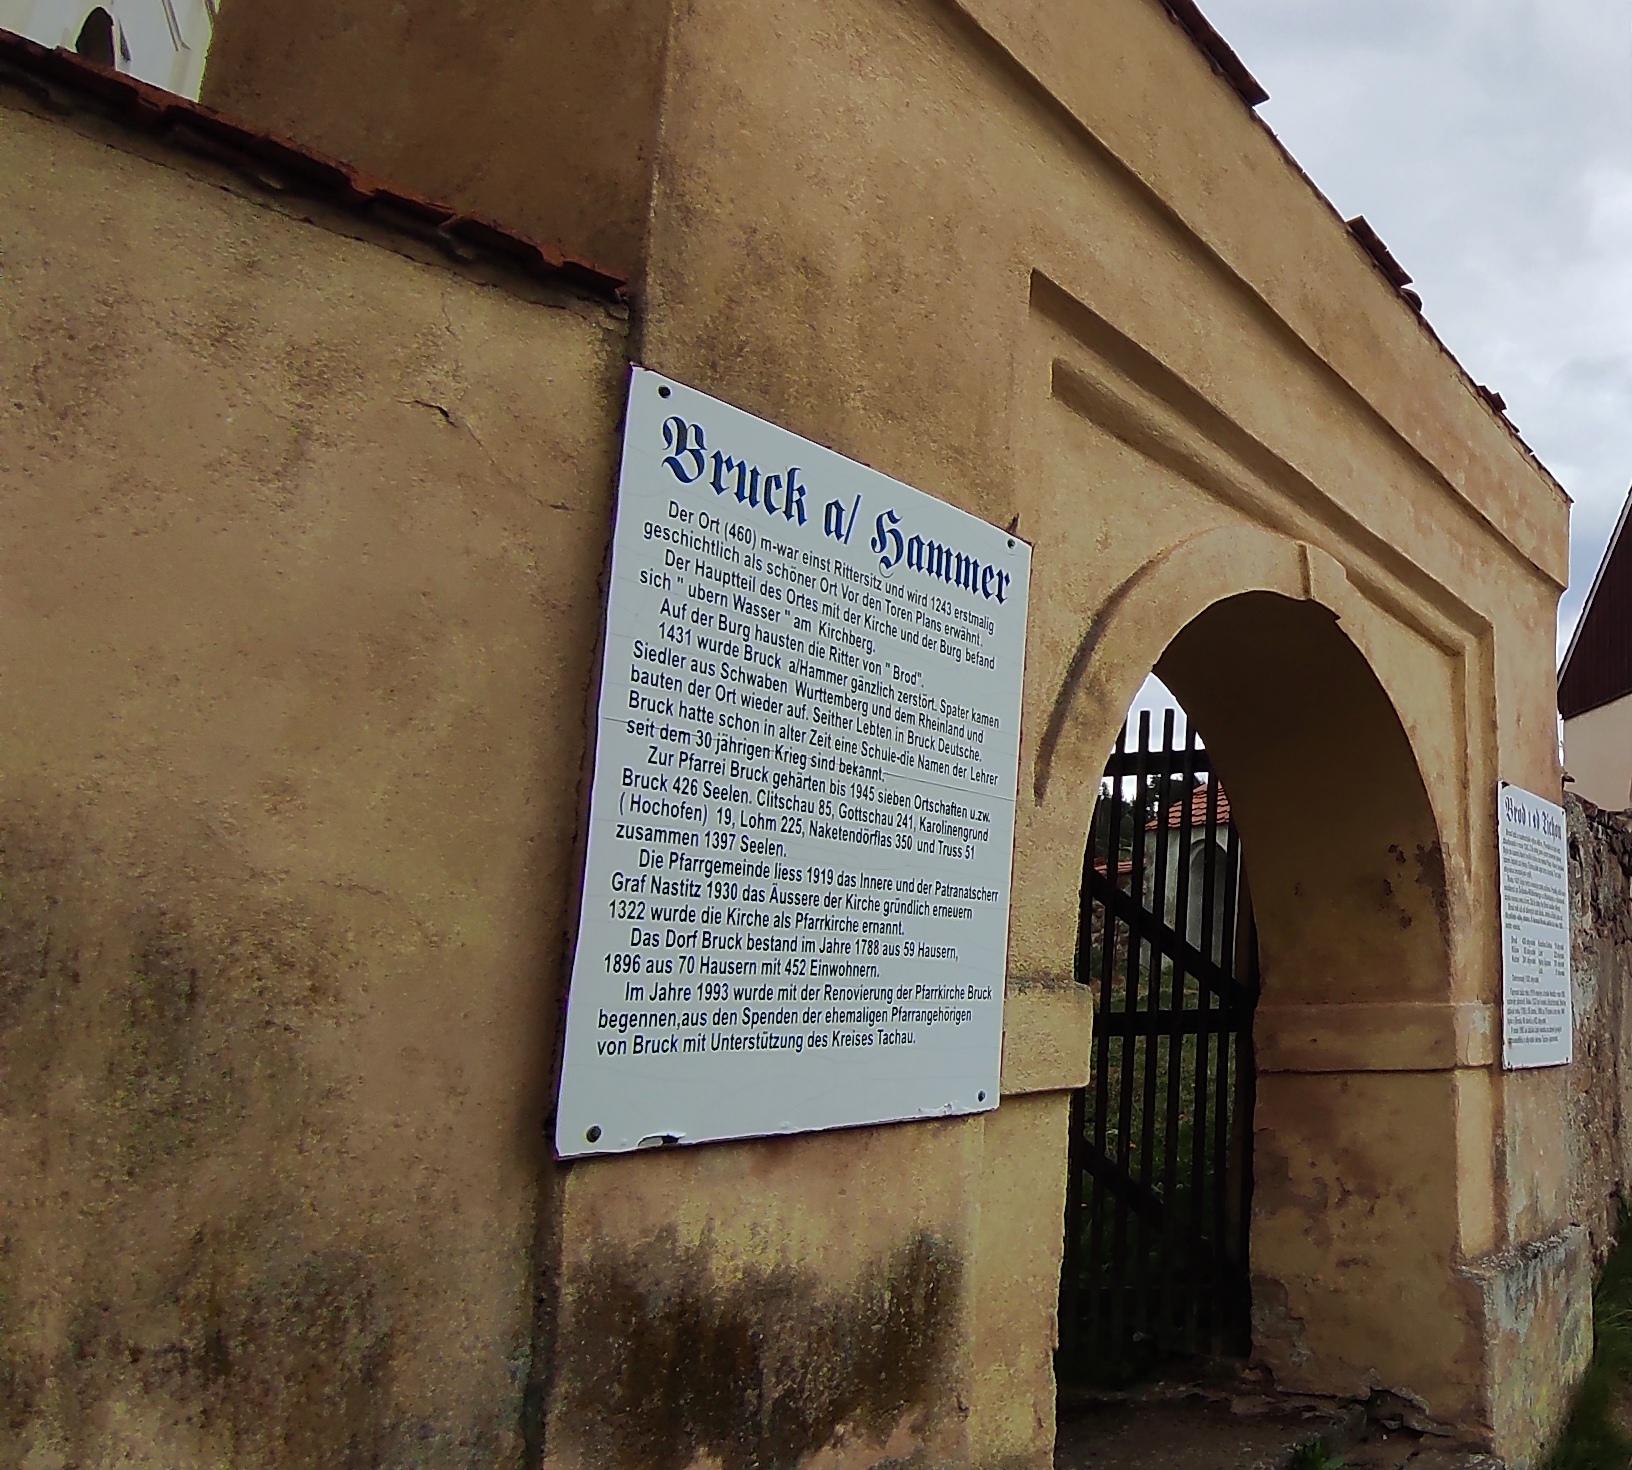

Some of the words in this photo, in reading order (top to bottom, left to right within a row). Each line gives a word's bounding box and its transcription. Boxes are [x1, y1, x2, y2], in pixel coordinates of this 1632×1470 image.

[661, 416, 807, 527] Bruck
[824, 494, 862, 545] a/
[870, 509, 1011, 605] Hammer
[643, 521, 740, 564] geschichtlich
[743, 552, 763, 572] als
[766, 562, 817, 590] schöner
[819, 576, 838, 597] Ort
[840, 583, 860, 604] Vor
[862, 592, 882, 612] den
[884, 598, 913, 623] Toren
[915, 610, 942, 633] Plans
[668, 500, 695, 524] Der
[698, 511, 720, 535] Ort
[724, 521, 757, 551] (460)
[760, 537, 800, 561] m-war
[802, 550, 831, 573] einst
[833, 559, 883, 592] Rittersitz
[885, 582, 905, 599] und
[906, 589, 928, 608] wird
[930, 596, 952, 616] 1243
[954, 608, 995, 636] erstmalig
[664, 548, 691, 572] Der
[694, 558, 757, 593] Hauptteil
[759, 580, 782, 601] des
[786, 588, 819, 613] Ortes
[821, 602, 840, 620] mit
[843, 607, 862, 626] der
[863, 612, 898, 638] Kirche
[900, 628, 920, 645] und
[921, 633, 938, 651] der
[939, 638, 962, 663] Burg
[965, 647, 995, 670] befand
[632, 639, 687, 669] Siedler
[690, 658, 716, 677] aus
[719, 661, 788, 694] Schwaben
[871, 703, 892, 719] und
[894, 706, 916, 726] dem
[918, 712, 965, 738] Rheinland
[966, 729, 984, 744] und
[658, 621, 692, 646] 1431
[696, 635, 740, 658] wurde
[743, 643, 782, 670] Bruck
[788, 658, 849, 687] a/Hammer
[850, 674, 895, 701] gänzlich
[939, 698, 970, 720] Spater
[971, 707, 1000, 729] kamen
[628, 689, 674, 717] Bruck
[678, 700, 714, 725] hatte
[718, 712, 760, 734] schon
[763, 718, 776, 737] in
[778, 723, 807, 744] alter
[808, 728, 832, 750] Zeit
[834, 735, 858, 755] eine
[917, 753, 950, 775] Namen
[952, 762, 968, 779] der
[970, 766, 999, 786] Lehrer
[630, 663, 683, 693] bauten
[687, 678, 712, 699] der
[715, 684, 737, 705] Ort
[740, 691, 784, 715] wieder
[786, 703, 809, 721] auf.
[812, 706, 854, 731] Seither
[856, 716, 892, 741] Lebten
[894, 725, 905, 744] in
[907, 729, 936, 751] Bruck
[937, 737, 982, 763] Deutsche.
[621, 767, 669, 793] Bruck
[672, 776, 698, 797] 426
[702, 780, 753, 805] Seelen.
[818, 798, 835, 820] 85,
[838, 802, 894, 827] Gottschau
[919, 815, 989, 843] Karolinengrund
[647, 745, 675, 767] Zur
[678, 750, 727, 776] Pfarrei
[730, 759, 770, 783] Bruck
[829, 778, 847, 797] bis
[850, 782, 875, 802] 1945
[877, 788, 911, 809] sieben
[913, 794, 968, 819] Ortschaften
[615, 823, 699, 848] zusammen
[704, 830, 737, 851] 1397
[739, 834, 787, 858] Seelen.
[609, 898, 646, 920] 1322
[650, 904, 696, 923] wurde
[701, 905, 722, 925] die
[726, 906, 770, 928] Kirche
[773, 910, 792, 929] als
[794, 911, 859, 933] Pfarrkirche
[861, 920, 905, 936] ernannt.
[611, 871, 648, 893] Graf
[650, 874, 702, 898] Nastitz
[706, 880, 738, 901] 1930
[742, 883, 766, 903] das
[768, 886, 820, 908] Äussere
[823, 890, 843, 909] der
[845, 893, 881, 912] Kirche
[882, 897, 930, 918] gründlich
[932, 905, 973, 919] erneuern
[604, 953, 641, 974] 1896
[645, 959, 673, 974] aus
[678, 955, 695, 975] 70
[699, 955, 757, 975] Hausern
[760, 957, 782, 976] mit
[784, 958, 807, 976] 452
[809, 958, 880, 978] Einwohnern.
[630, 927, 660, 948] Das
[665, 928, 699, 949] Dorf
[701, 930, 743, 950] Bruck
[746, 932, 798, 953] bestand
[801, 935, 816, 953] im
[818, 936, 852, 955] Jahre
[854, 938, 880, 956] 1788
[882, 944, 901, 957] aus
[903, 941, 915, 957] 59
[625, 981, 644, 1001] Im
[649, 981, 692, 1002] Jahre
[696, 982, 729, 1001] 1993
[733, 983, 774, 1001] wurde
[777, 983, 797, 1002] mit
[800, 983, 821, 1001] der
[823, 983, 894, 1005] Renovierung
[896, 984, 913, 1000] der
[914, 984, 965, 1000] Pfarrkirche
[967, 984, 993, 1001] Bruck
[712, 1007, 738, 1026] den
[741, 1006, 799, 1030] Spenden
[802, 1006, 823, 1024] der
[824, 1006, 888, 1028] ehemaligen
[890, 1005, 972, 1026] Pfarrangehörigen
[597, 1040, 627, 1056] von
[632, 1033, 679, 1055] Bruck
[682, 1032, 707, 1053] mit
[710, 1030, 804, 1054] Unterstützung
[807, 1030, 828, 1048] des
[831, 1029, 874, 1048] Kreises
[876, 1028, 916, 1046] Tachau.
